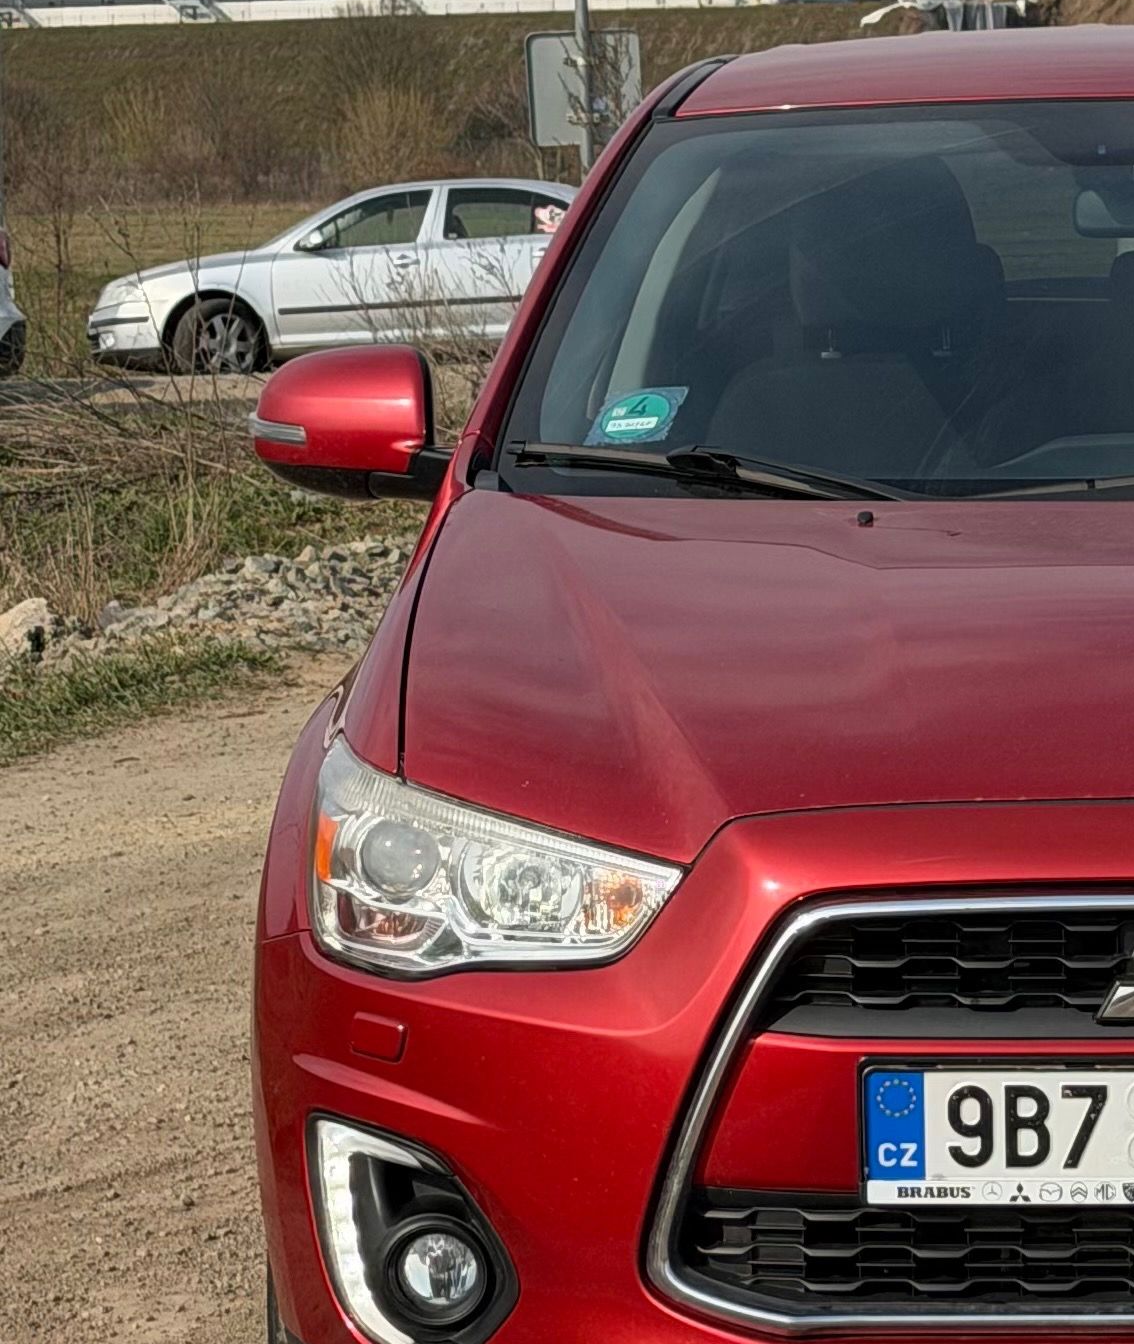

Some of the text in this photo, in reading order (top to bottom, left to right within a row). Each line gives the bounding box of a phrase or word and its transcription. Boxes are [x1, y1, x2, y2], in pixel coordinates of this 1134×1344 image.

[628, 396, 650, 415] 4
[947, 1084, 1108, 1168] 9B7
[878, 1142, 918, 1168] CZ
[897, 1186, 971, 1199] BRABUS
